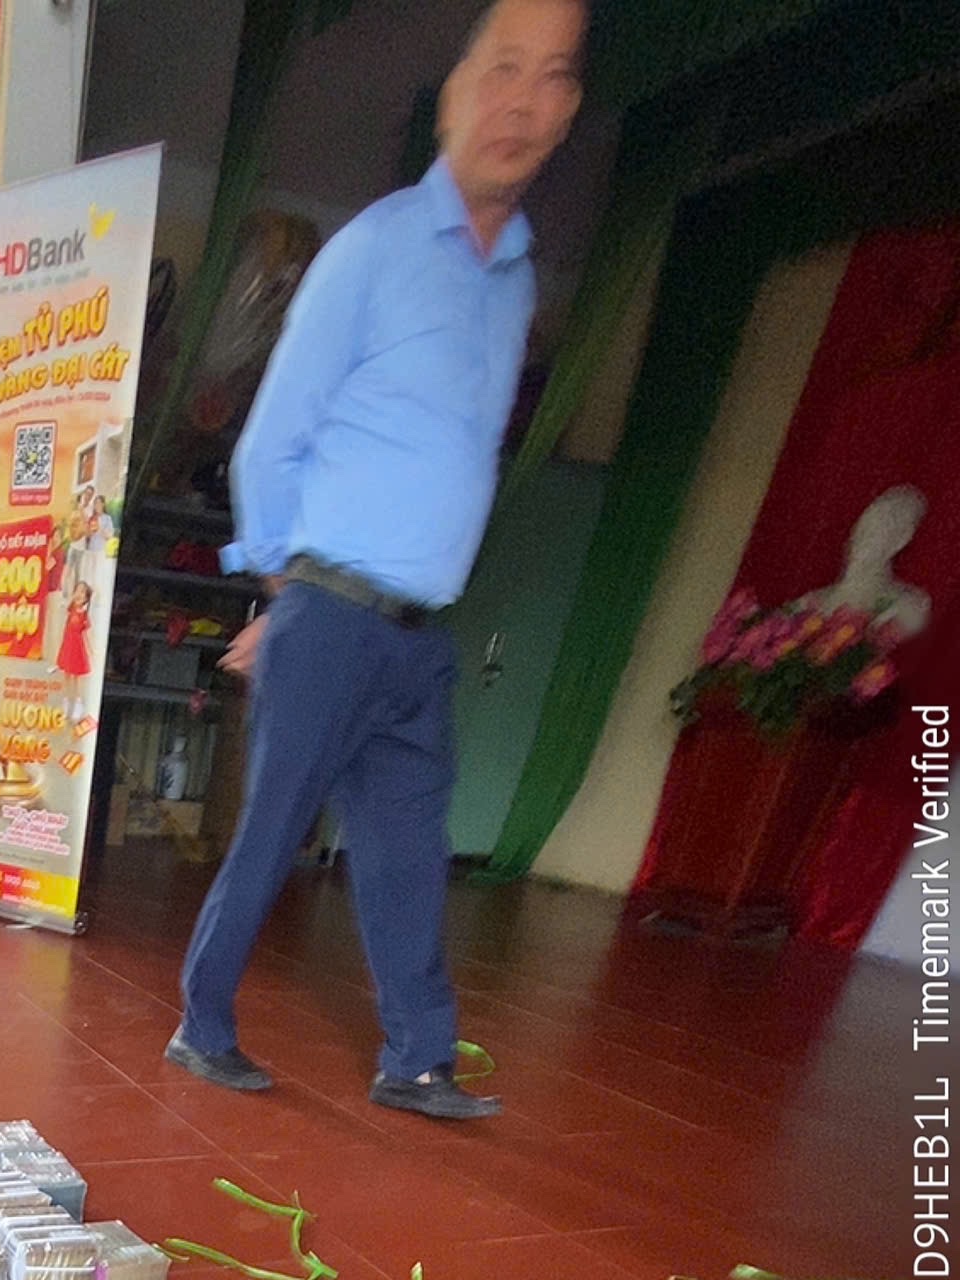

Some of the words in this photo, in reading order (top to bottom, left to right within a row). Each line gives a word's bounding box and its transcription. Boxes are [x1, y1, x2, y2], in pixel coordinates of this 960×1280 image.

[23, 301, 54, 357] TỶ
[57, 286, 110, 346] PHÚ
[51, 352, 88, 389] ĐẠI
[90, 342, 131, 382] CÁT
